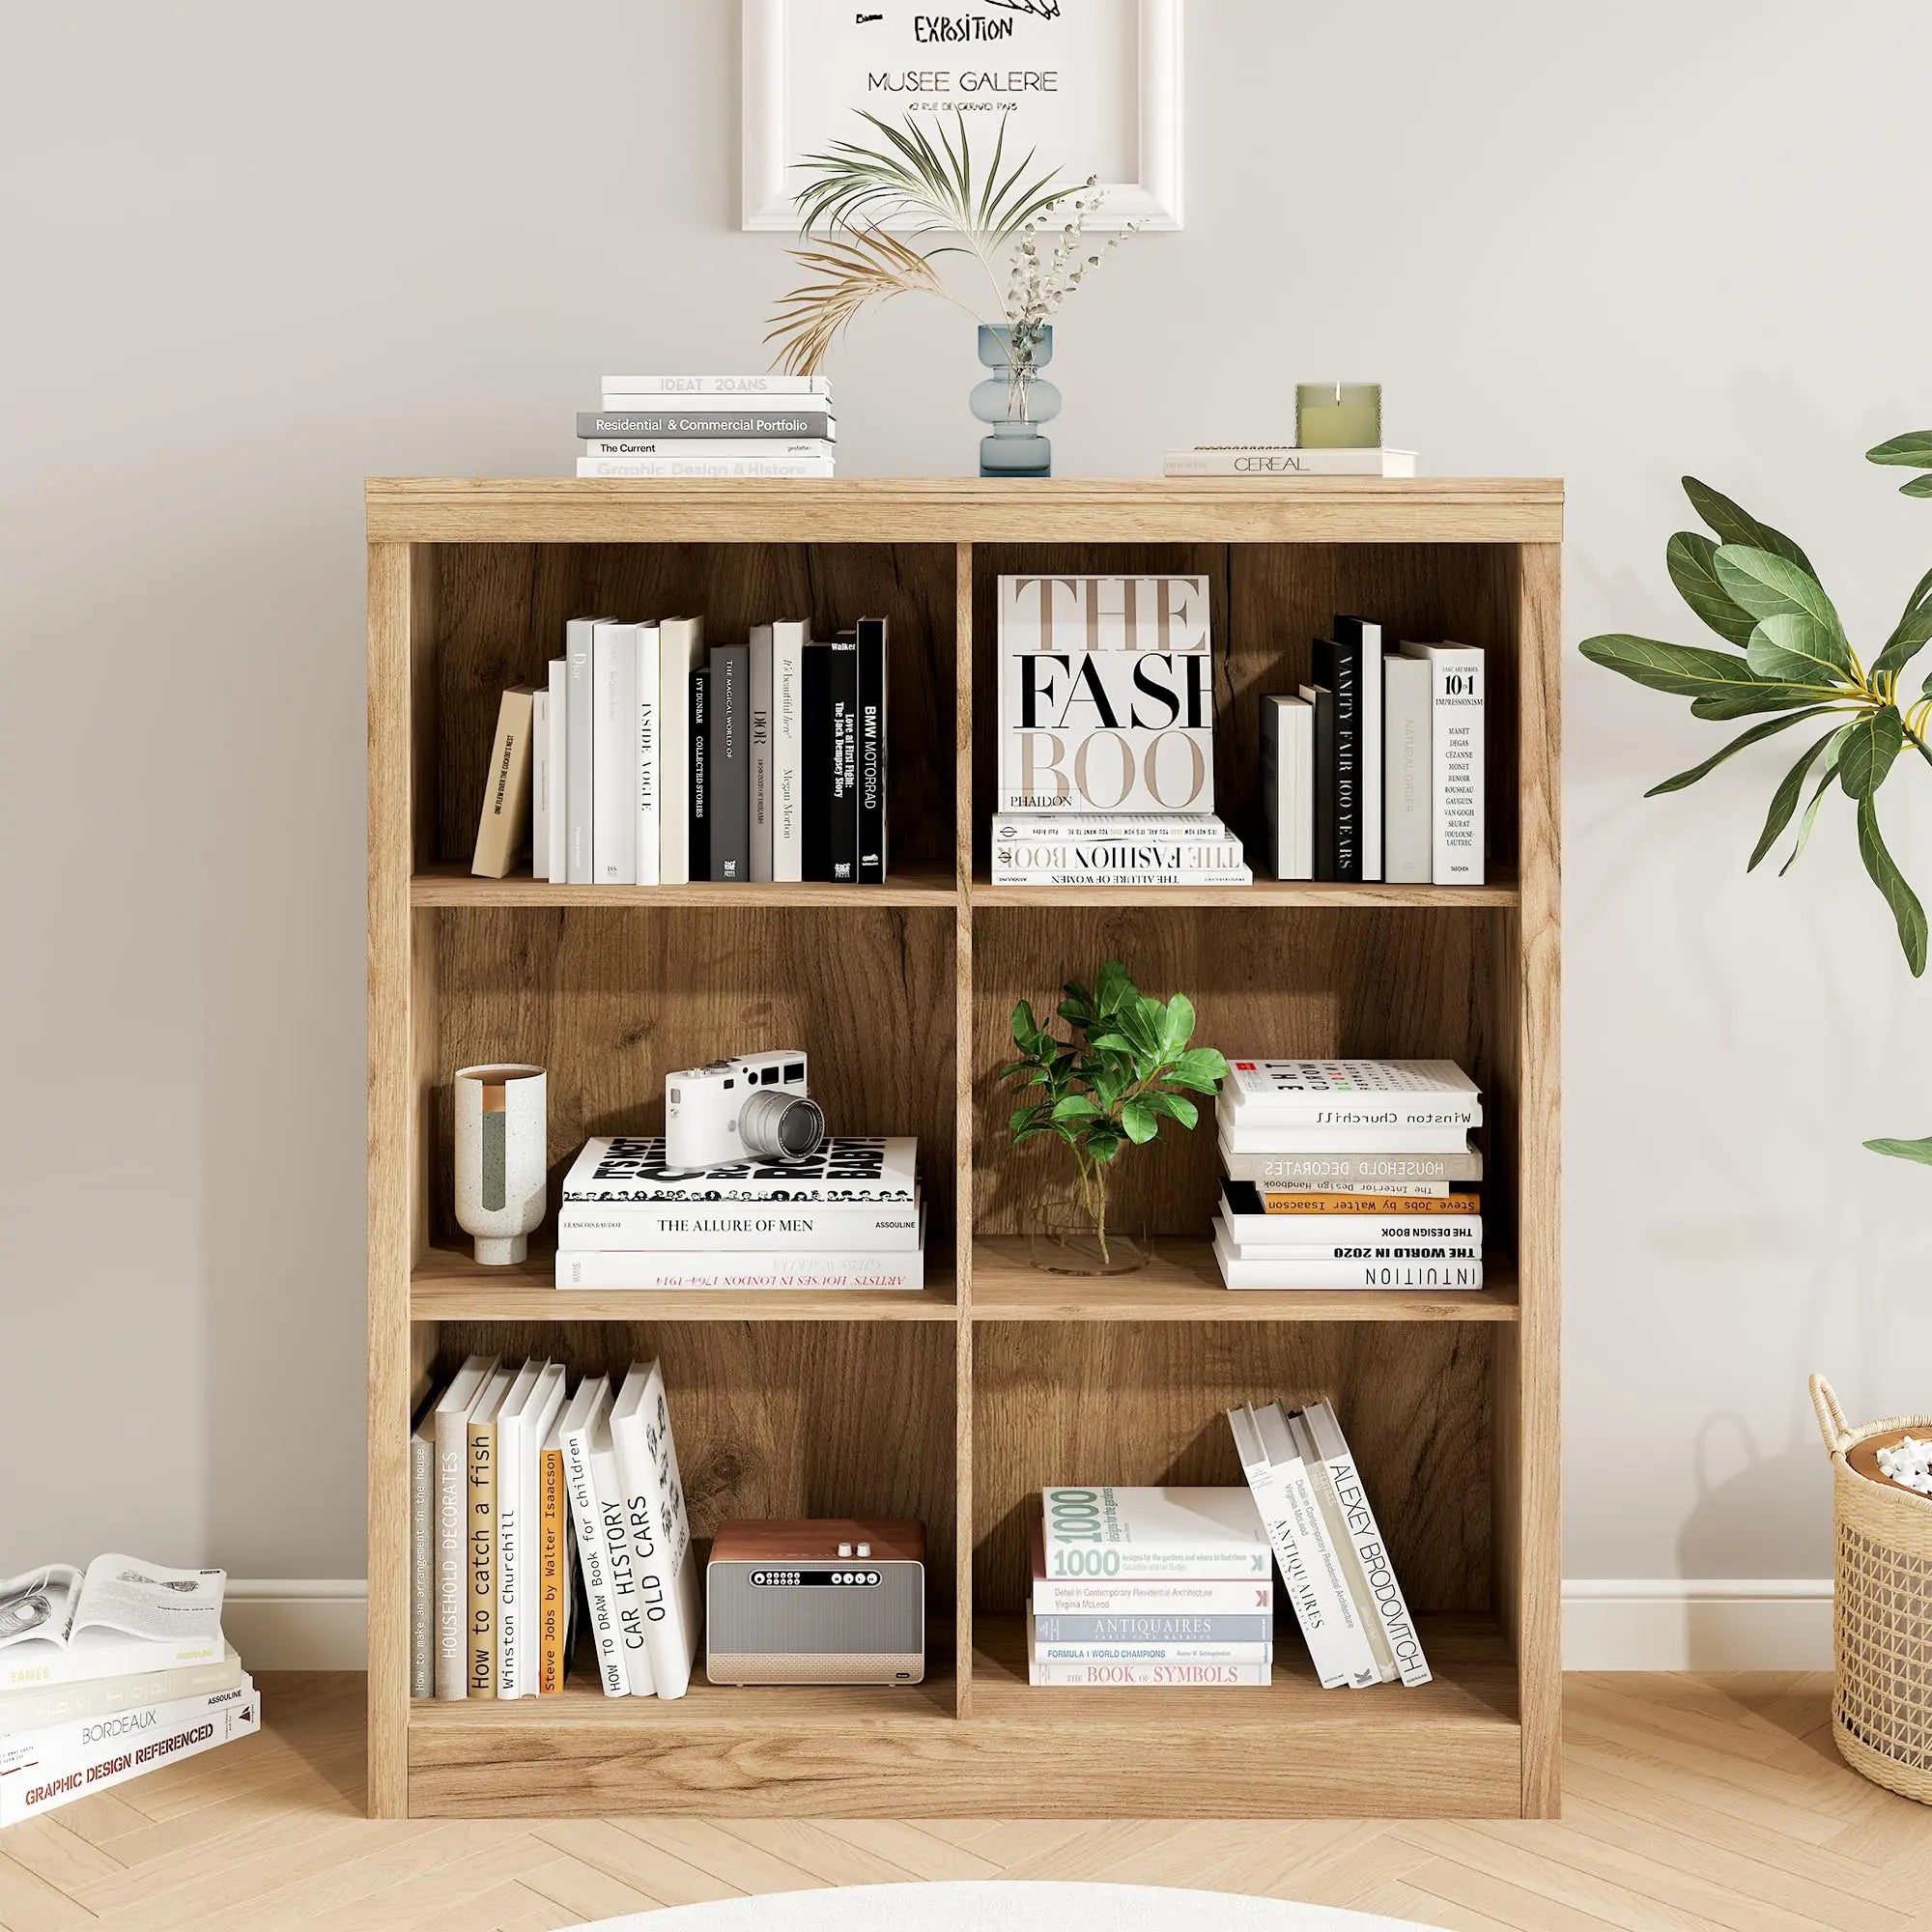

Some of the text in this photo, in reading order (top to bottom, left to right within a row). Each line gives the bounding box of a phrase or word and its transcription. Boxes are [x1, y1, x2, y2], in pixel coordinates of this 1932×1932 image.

[914, 14, 1013, 44] EXPOSITION
[867, 71, 1058, 93] MUSEE GALERIE
[596, 419, 808, 431] Residential & Commercial Portfolio
[1235, 457, 1310, 471] CEREAL
[1014, 579, 1207, 652] THE
[1339, 656, 1352, 721] VANITY
[1445, 675, 1473, 695] 10 1
[753, 711, 767, 745] DIOR
[844, 713, 855, 732] Love
[641, 703, 651, 811] INSIDE VOGUE
[834, 701, 844, 798] The Jack Dempsey Story
[844, 745, 855, 762] First
[865, 706, 876, 809] BMW MOTORRAD
[1339, 730, 1352, 772] FAIR
[844, 764, 855, 788] Fight:
[781, 769, 793, 839] Megan Morton
[1010, 795, 1072, 808] PHAIDON
[1339, 814, 1352, 869] YEARS
[1075, 846, 1180, 869] FASHION
[1189, 846, 1239, 869] THE
[1051, 875, 1179, 884] THE ALLURE OF WOMEN
[592, 1138, 655, 1179] IT'S NOT
[826, 1138, 887, 1179] BABY!
[1263, 1180, 1312, 1189] Handbook
[1317, 1182, 1354, 1191] Design
[1359, 1184, 1408, 1193] Interior
[1268, 1201, 1475, 1210] Steve Jobs by Walter Isaacson
[657, 1219, 814, 1233] THE ALLURE OF MEN
[1381, 1228, 1473, 1237] THE DESIGN BOOK
[1333, 1247, 1475, 1258] THE WORLD IN 2020
[724, 1275, 777, 1286] LONDON
[796, 1275, 847, 1286] HOUSES
[1366, 1267, 1476, 1286] INTUITION
[1050, 1490, 1103, 1544] 1000
[441, 1451, 458, 1659] HOUSEHOLD DECORATES
[471, 1435, 490, 1690] How to catch a fish
[569, 1436, 621, 1691] HOW TO DRAW Book for children
[627, 1495, 667, 1622] OLD CARS
[1054, 1548, 1121, 1577] 1000
[415, 1448, 427, 1690] How to make an arrangement in the house
[544, 1452, 558, 1690] Steve Jobs by Walter Isaacson
[601, 1500, 644, 1650] CAR HISTORY
[1274, 1519, 1325, 1631] ANTIQUAIRES
[1329, 1464, 1422, 1673] ALEXEY BRODOVITCH
[502, 1509, 515, 1690] Winston Churchill
[1094, 1619, 1211, 1633] ANTIQUAIRES
[1047, 1650, 1084, 1659] FORMULA
[1121, 1650, 1166, 1659] CHAMPIONS
[11, 1665, 49, 1683] EAMES
[1067, 1674, 1083, 1683] THE
[1087, 1666, 1135, 1683] BOOK
[1153, 1666, 1238, 1683] SYMBOLS
[208, 1690, 242, 1706] ASSOULINE
[82, 1709, 156, 1745] BORDEAUX
[25, 1772, 83, 1805] GRAPHIC
[86, 1753, 132, 1783] DESIGN
[135, 1722, 213, 1766] REFERENCED
